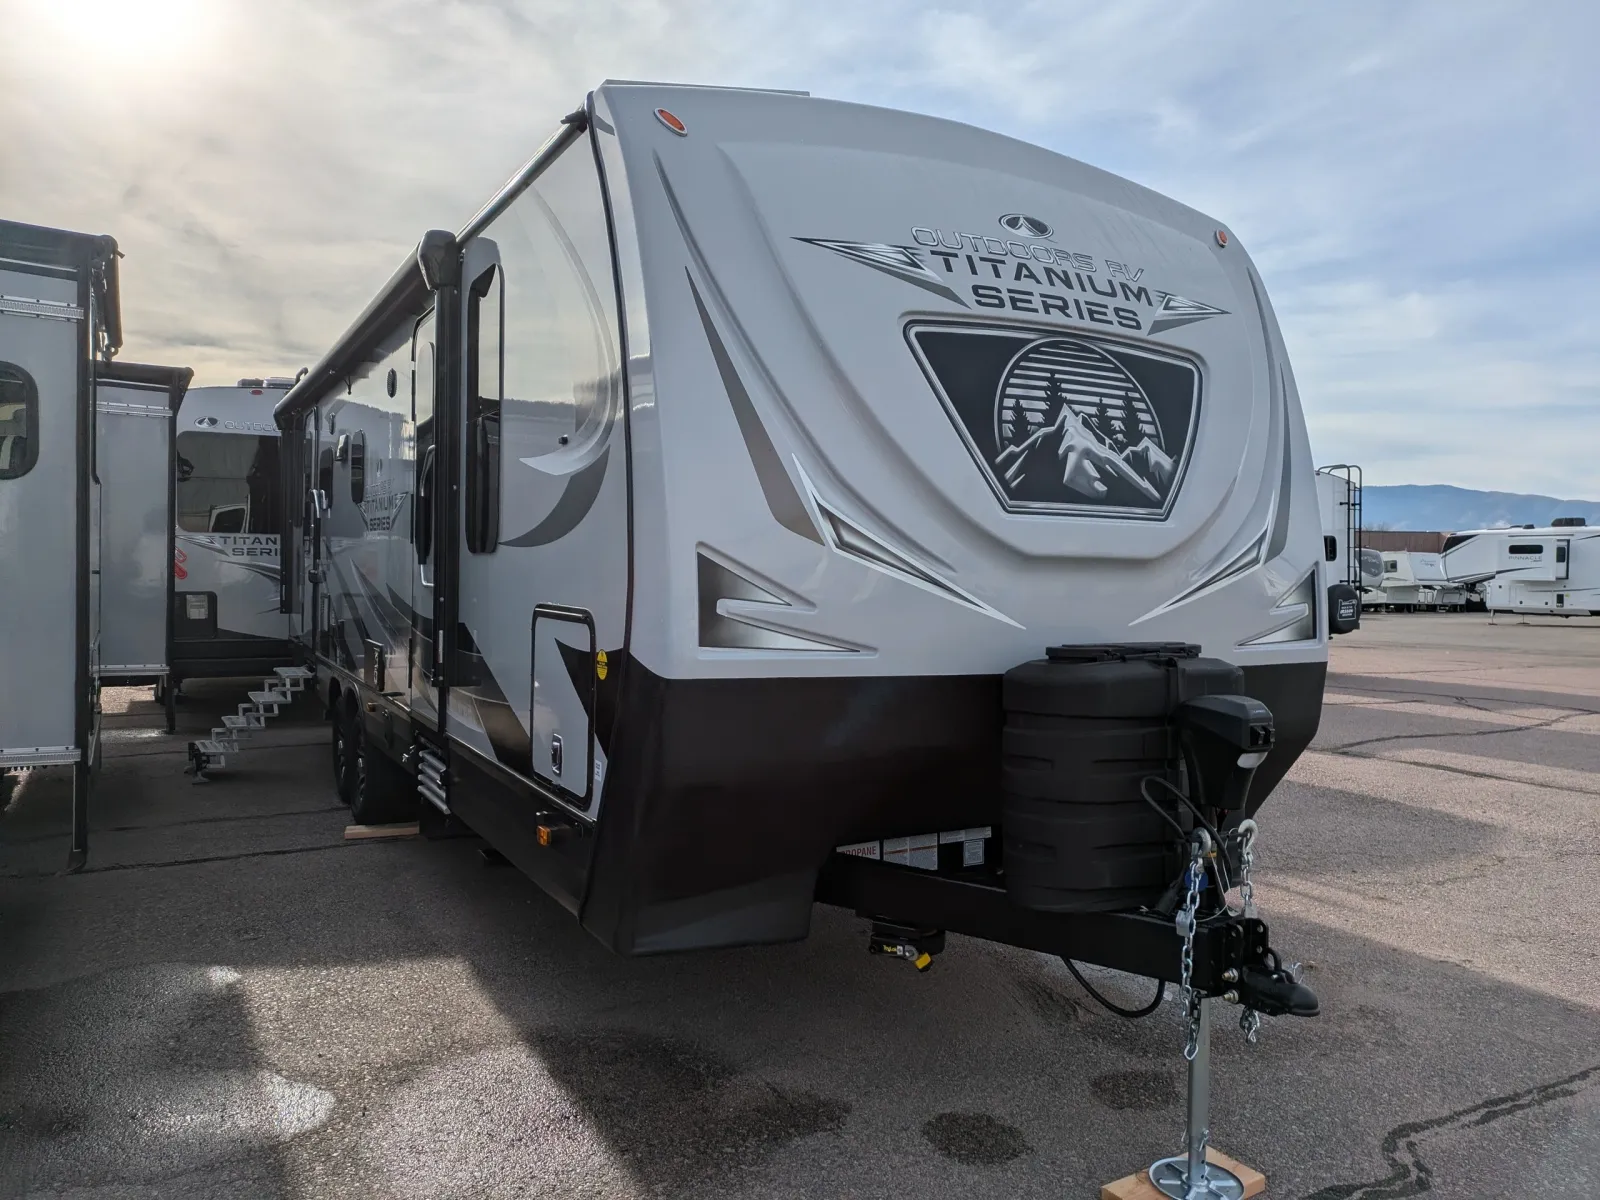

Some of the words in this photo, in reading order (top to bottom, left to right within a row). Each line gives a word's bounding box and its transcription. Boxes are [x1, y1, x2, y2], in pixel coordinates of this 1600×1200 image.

[911, 226, 1098, 273] OUTDOORS
[1105, 259, 1145, 283] RV
[929, 249, 1155, 307] TITANIUM
[971, 284, 1143, 332] SERIES
[370, 516, 391, 532] SERIES
[219, 535, 278, 546] TITAN
[232, 547, 278, 557] SERI
[842, 845, 877, 857] ROPANE
